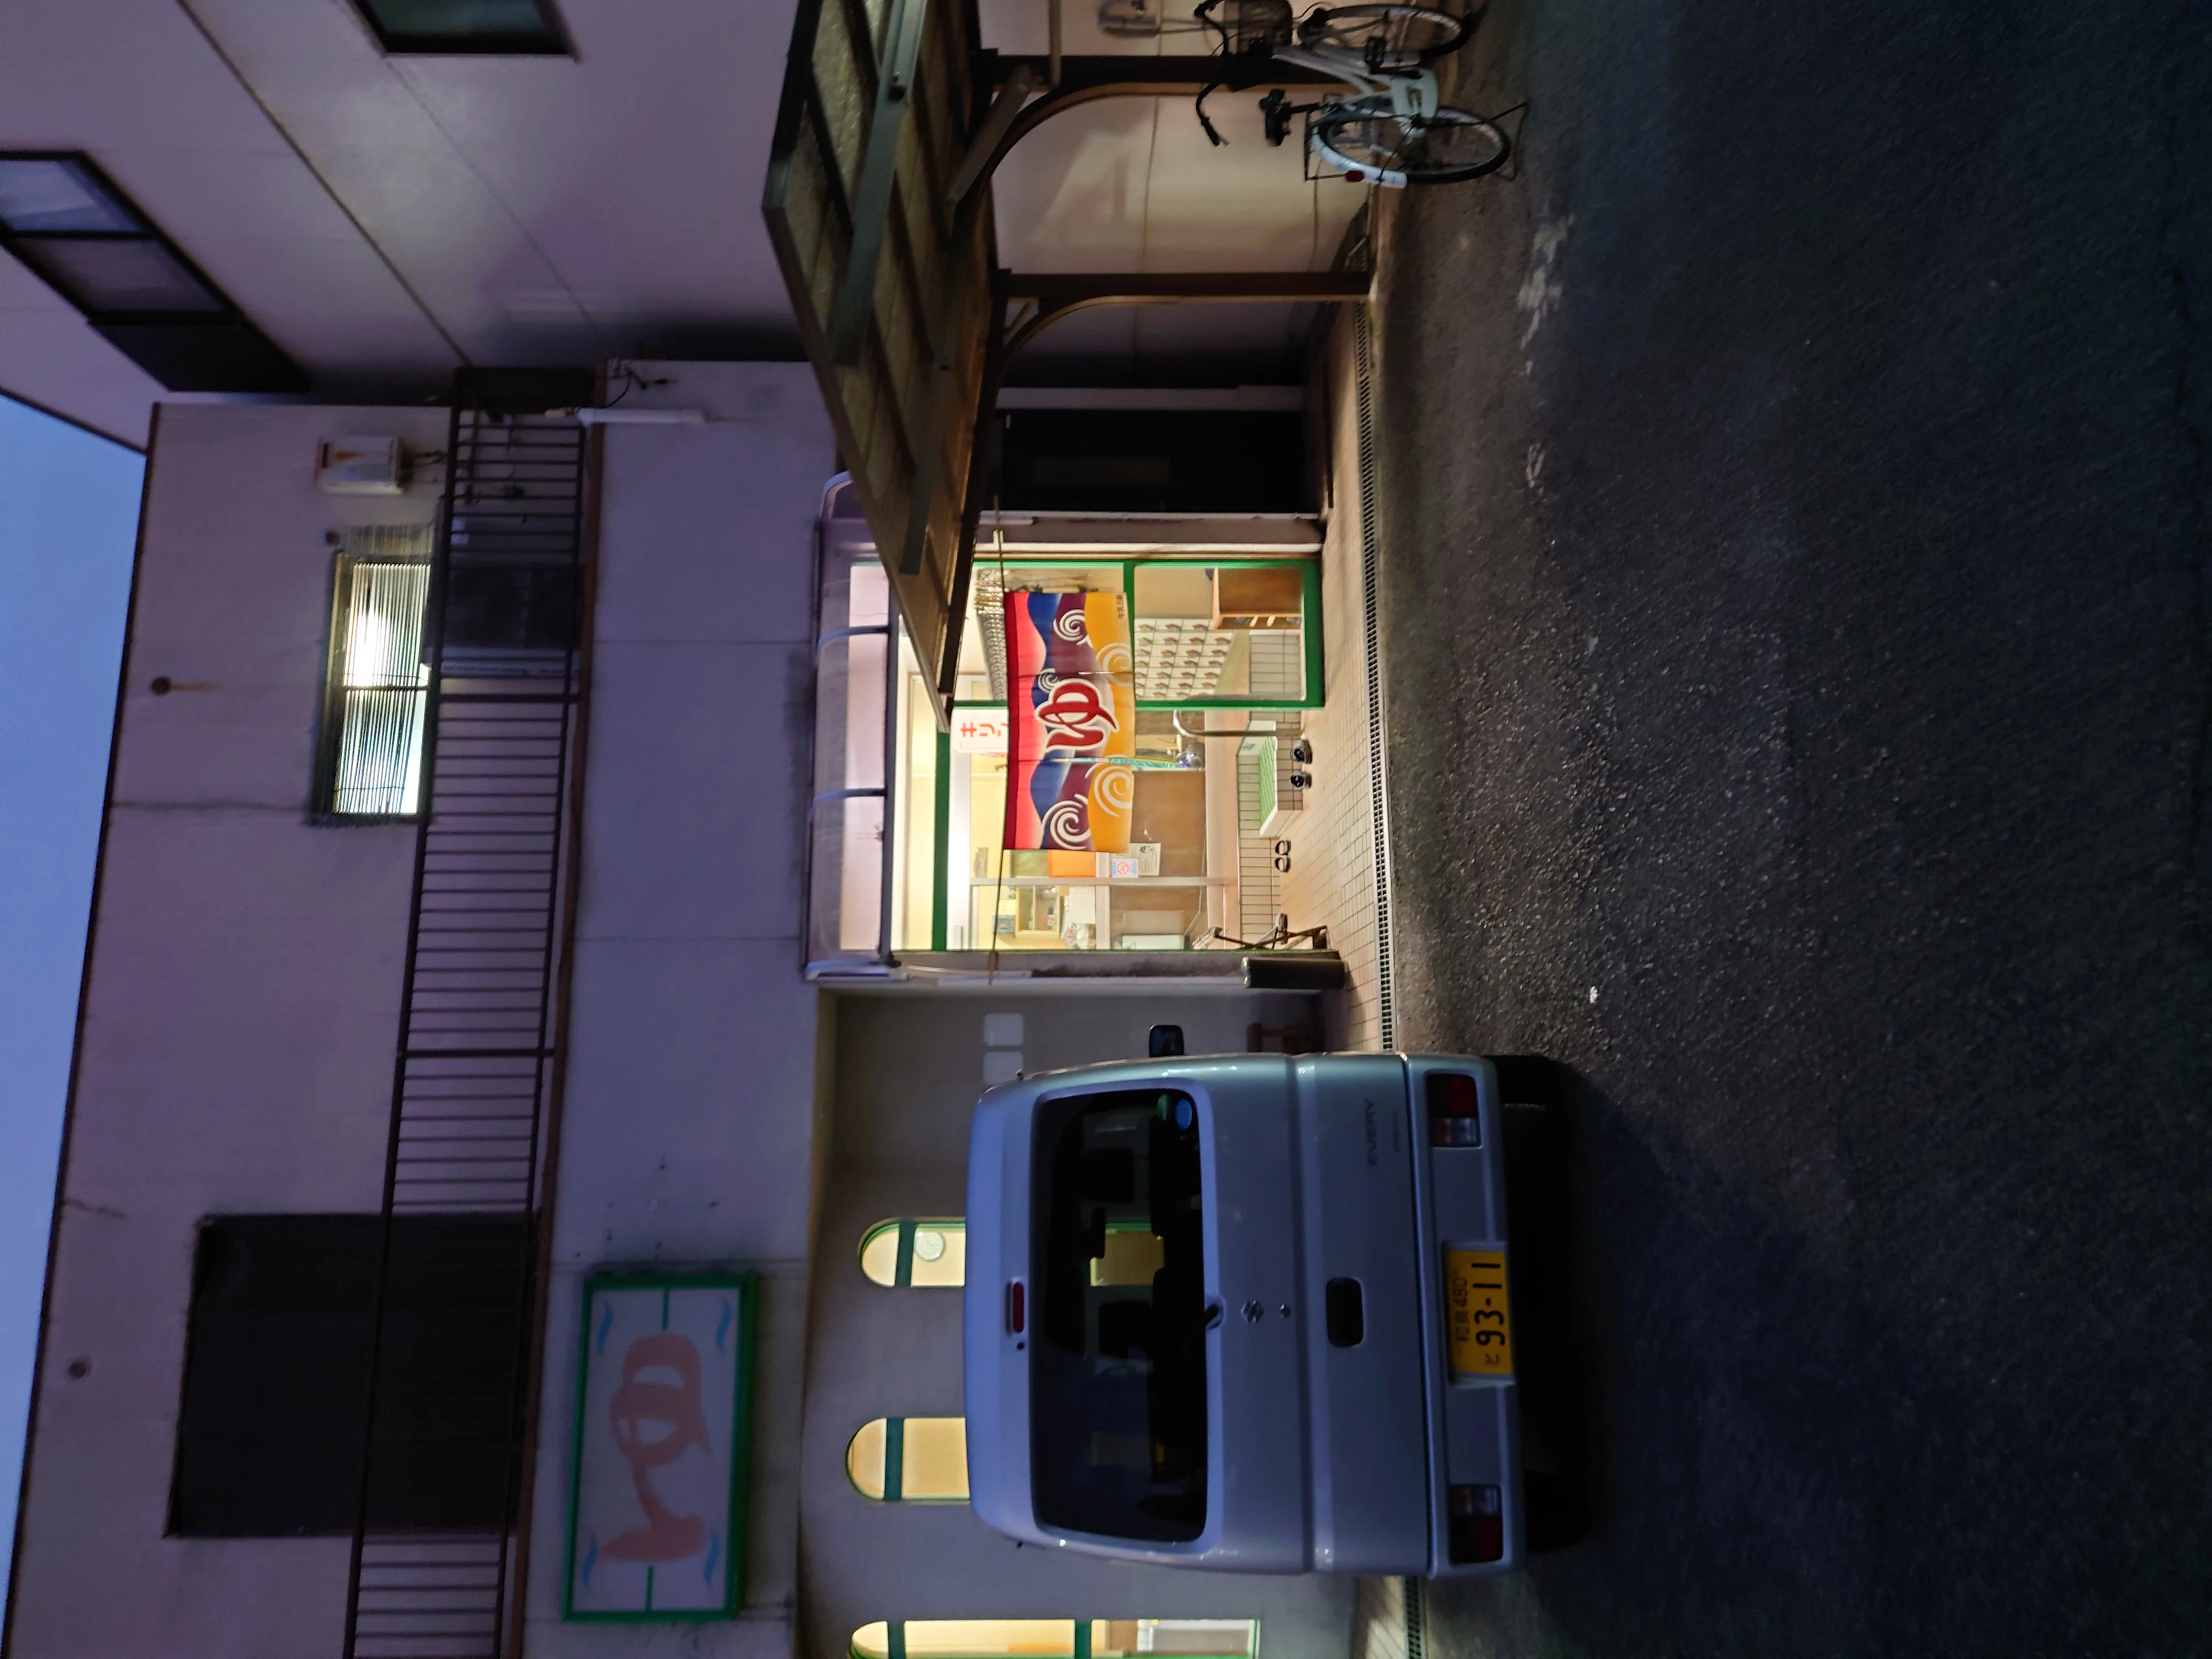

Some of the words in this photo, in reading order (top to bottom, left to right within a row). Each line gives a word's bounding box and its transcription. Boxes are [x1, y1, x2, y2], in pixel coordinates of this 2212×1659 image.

[1035, 680, 1118, 751] ゆ
[1364, 1098, 1378, 1167] EVERY
[1471, 1262, 1508, 1346] 93-11
[1483, 1353, 1499, 1365] と
[597, 1334, 712, 1561] ゆ
